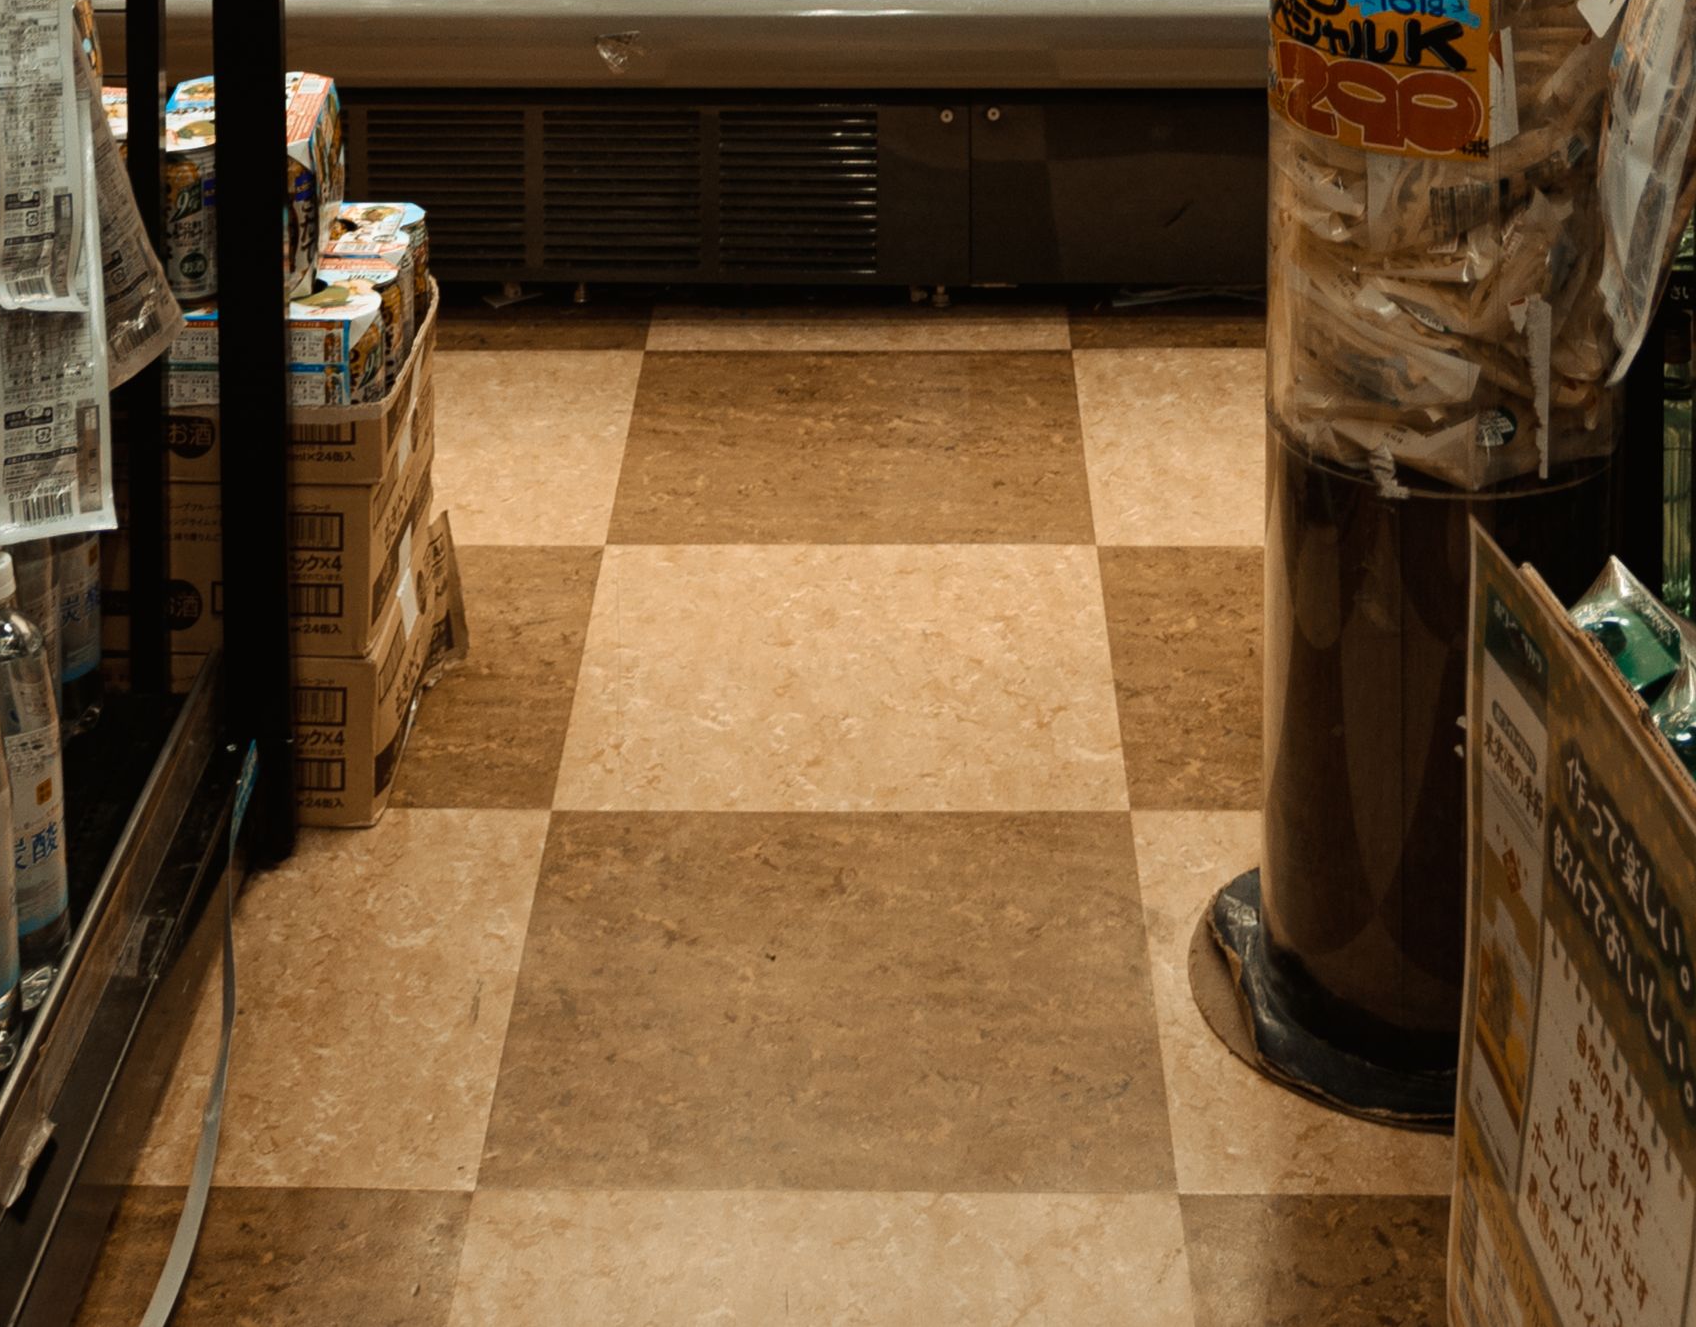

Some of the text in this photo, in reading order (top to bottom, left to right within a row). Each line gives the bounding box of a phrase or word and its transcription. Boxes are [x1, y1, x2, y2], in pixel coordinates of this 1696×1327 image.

[1552, 820, 1696, 1111] 飲んでおいしい。
[1566, 754, 1692, 996] 作って楽しい。
